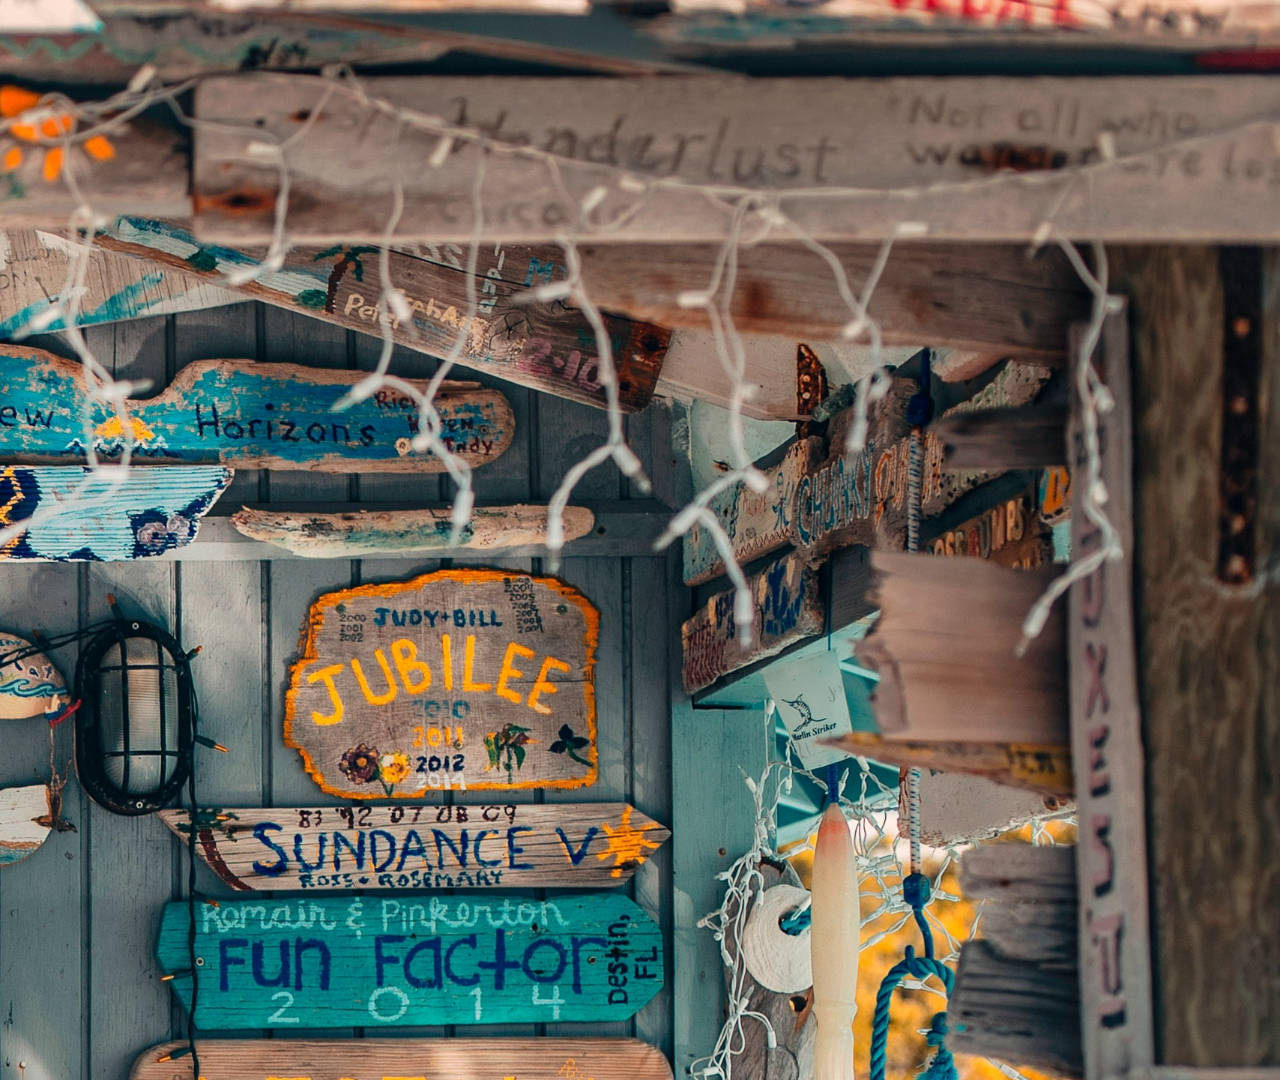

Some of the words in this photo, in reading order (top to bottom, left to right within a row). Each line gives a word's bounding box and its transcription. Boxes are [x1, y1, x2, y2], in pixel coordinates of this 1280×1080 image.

[195, 402, 378, 447] Horizons
[306, 633, 573, 727] JUBILEE
[412, 726, 466, 748] 2011
[414, 754, 467, 773] 2012
[252, 821, 537, 878] SUNDANCE
[555, 826, 600, 867] V
[381, 896, 571, 933] Pinkerton
[218, 936, 332, 993] Fun
[374, 928, 609, 994] Factor
[636, 944, 658, 982] FL
